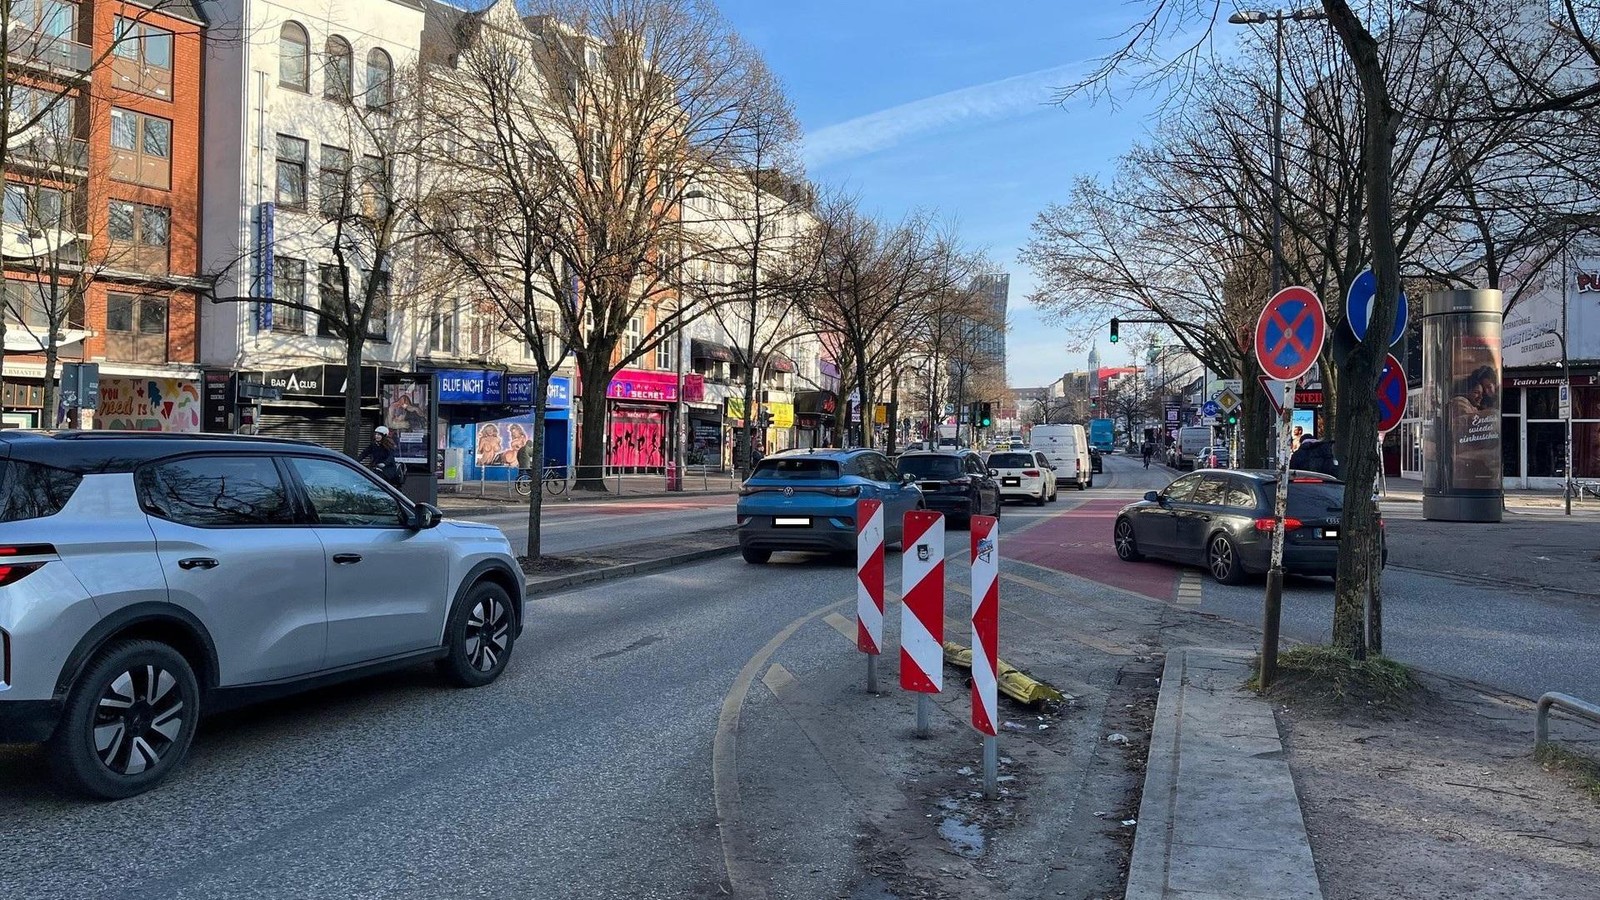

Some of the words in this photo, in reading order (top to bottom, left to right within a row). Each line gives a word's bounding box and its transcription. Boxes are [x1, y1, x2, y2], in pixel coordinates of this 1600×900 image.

[270, 379, 286, 388] BAR
[286, 372, 300, 391] A
[299, 380, 317, 389] CLUB
[442, 378, 461, 392] BLUE
[461, 379, 484, 394] NIGHT
[1513, 378, 1538, 386] Teatro
[101, 387, 119, 400] YOU
[507, 383, 518, 394] BLUE
[518, 383, 532, 395] NIGHT
[631, 390, 665, 400] SECRET
[99, 396, 134, 415] need
[137, 403, 148, 415] IS
